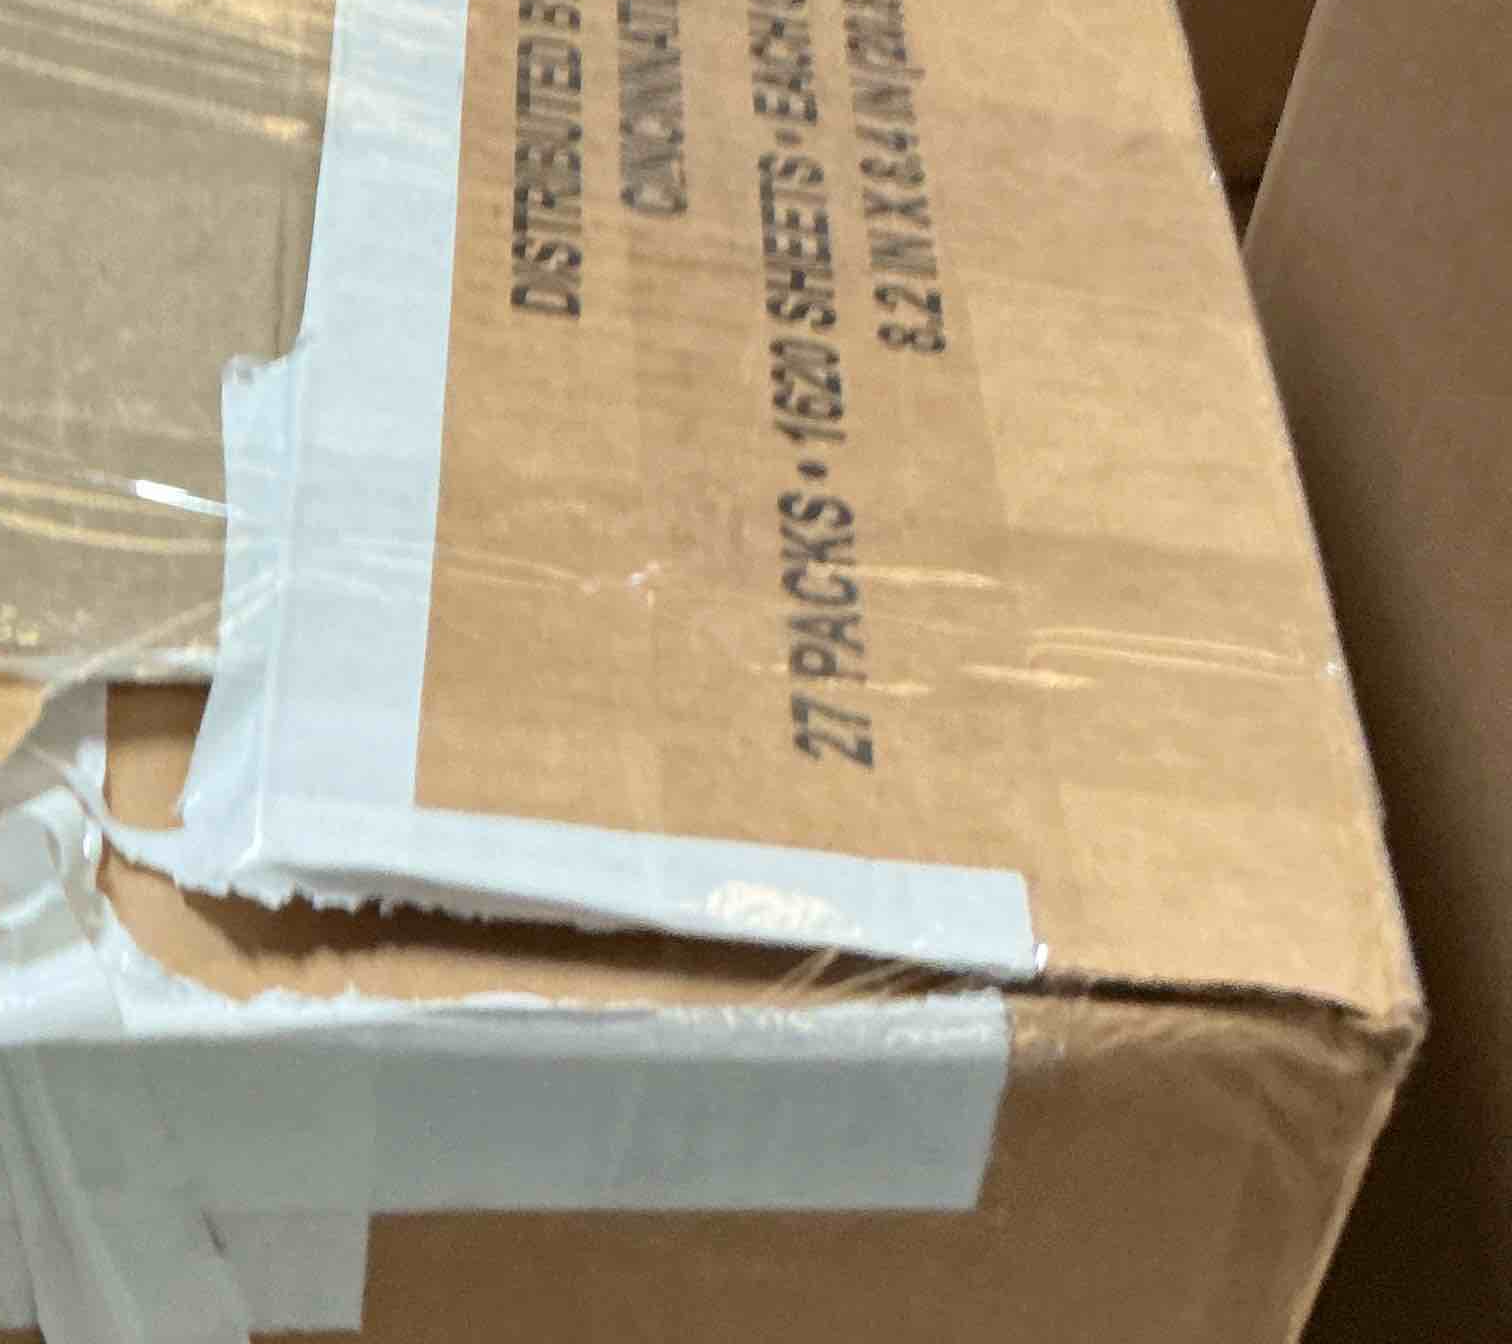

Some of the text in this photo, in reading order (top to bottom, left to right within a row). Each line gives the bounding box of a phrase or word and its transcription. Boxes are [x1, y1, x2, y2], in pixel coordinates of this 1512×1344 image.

[748, 12, 819, 126] EACH
[511, 36, 582, 319] DISTRIBUTED
[862, 190, 930, 231] X
[756, 152, 838, 332] SHEETS
[868, 233, 938, 282] IN
[874, 285, 948, 355] 8.2
[769, 339, 847, 448] 1620
[777, 490, 868, 685] PACKS
[790, 691, 875, 773] 27
